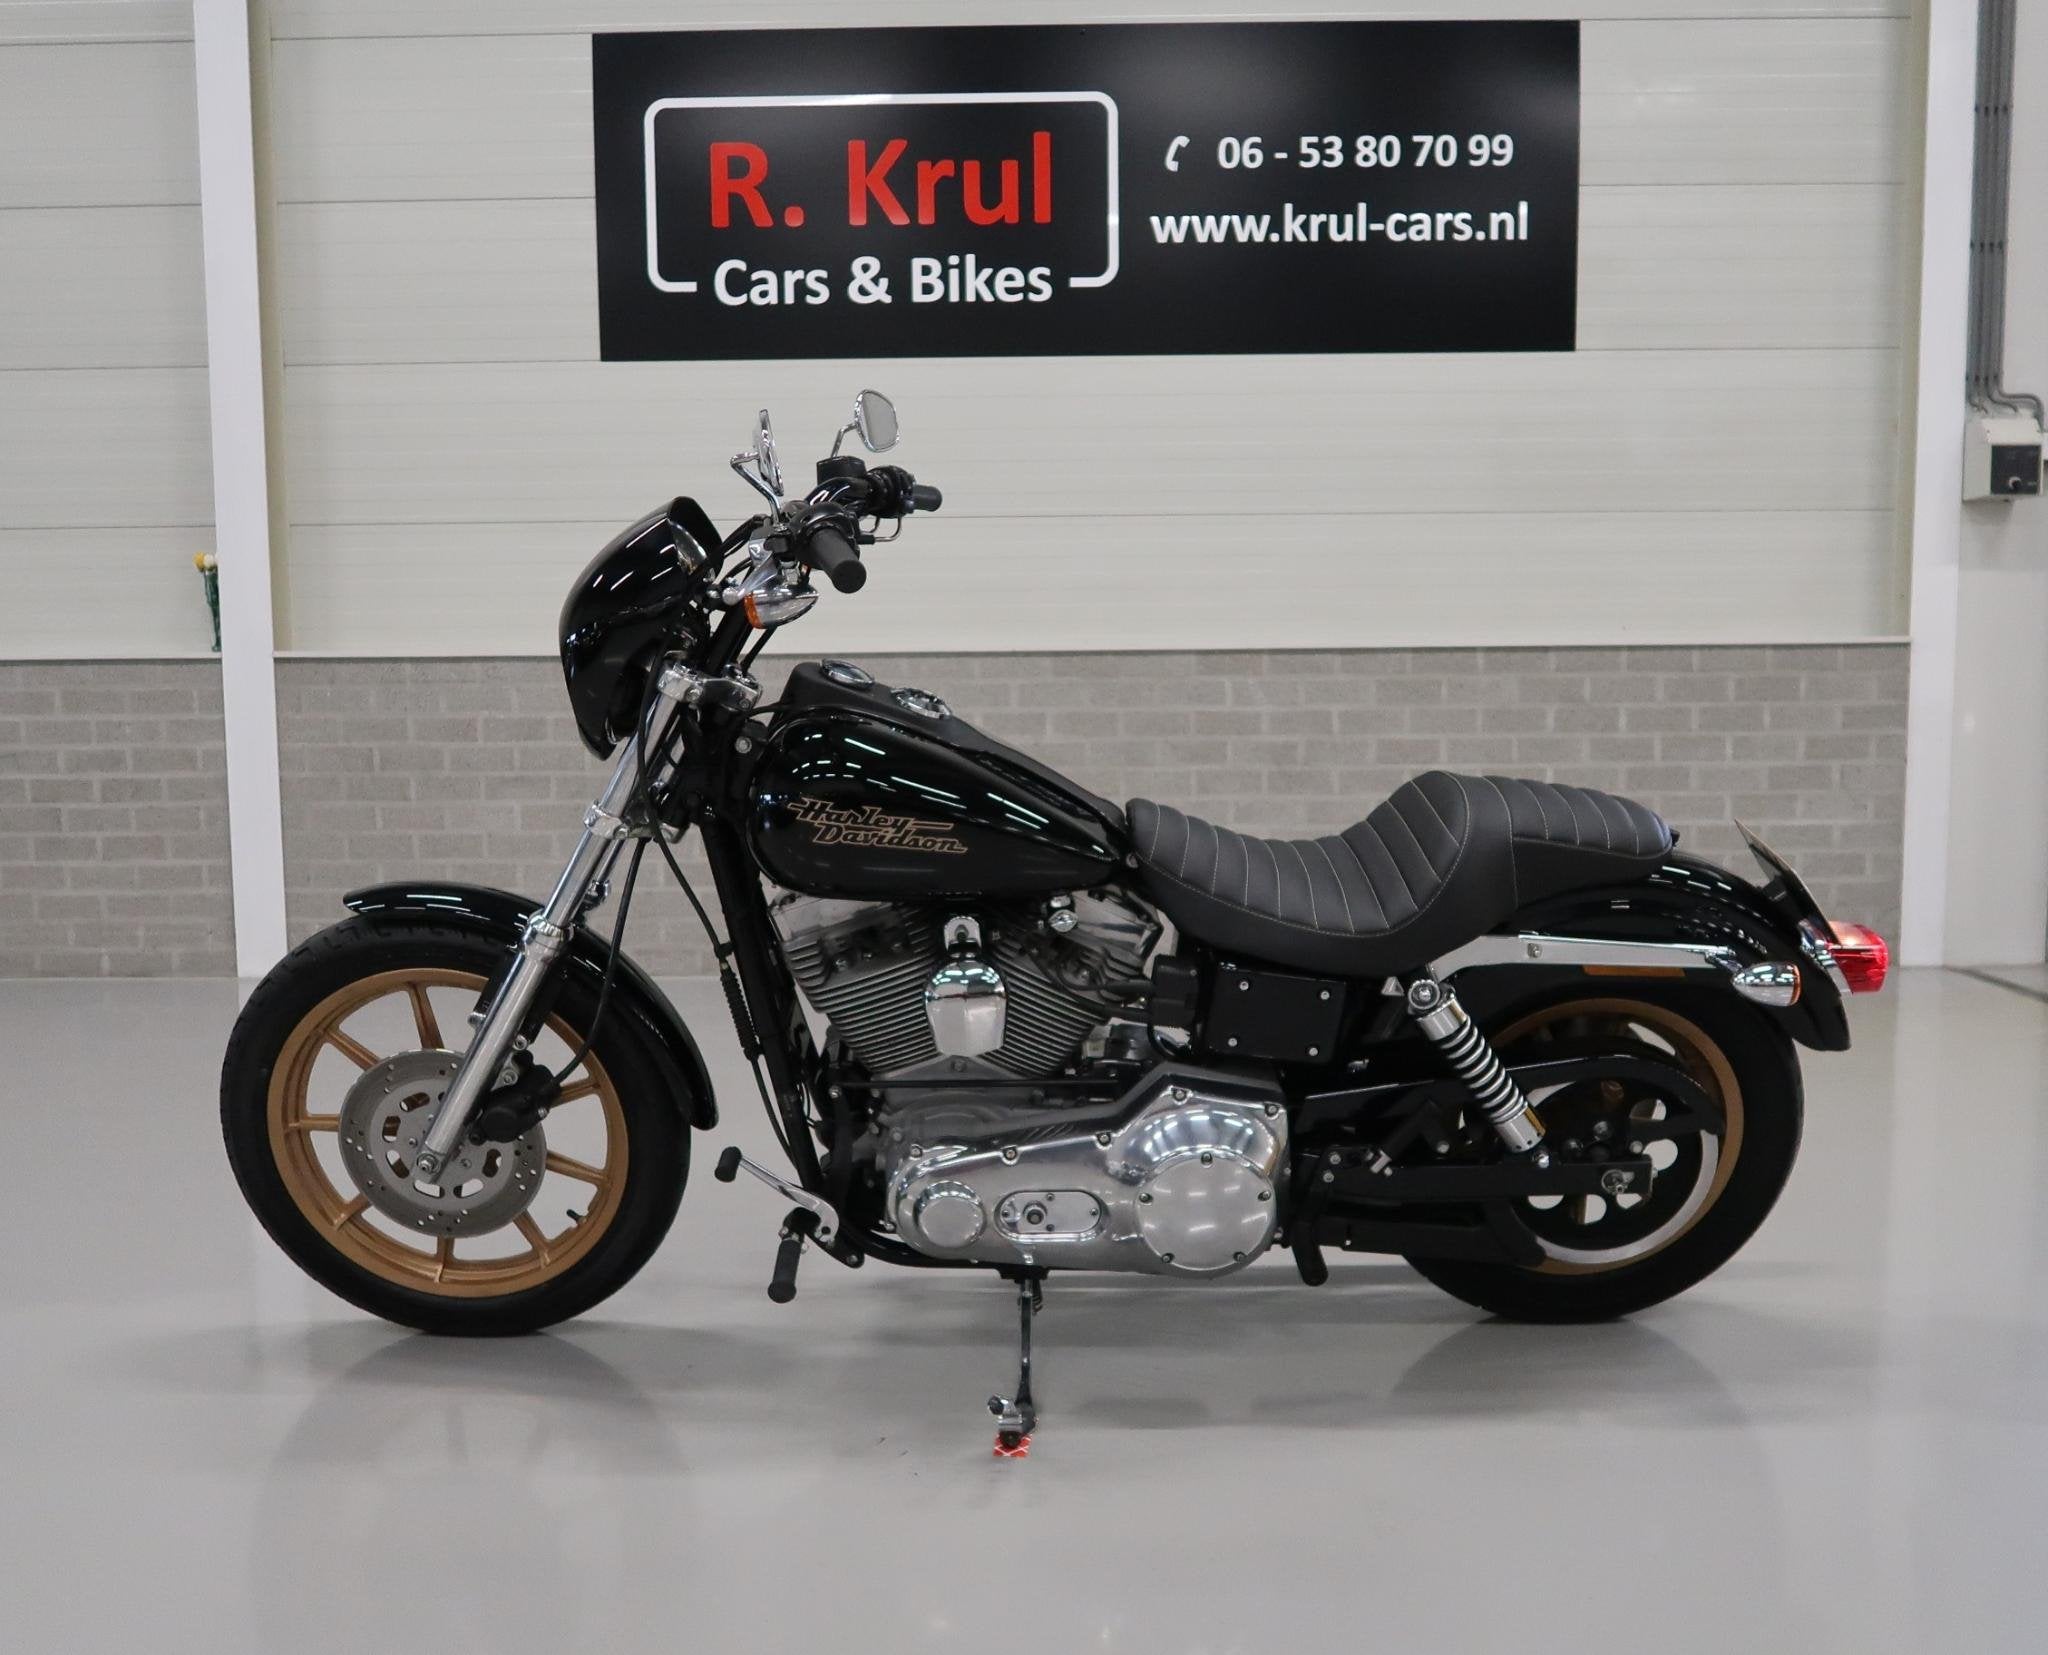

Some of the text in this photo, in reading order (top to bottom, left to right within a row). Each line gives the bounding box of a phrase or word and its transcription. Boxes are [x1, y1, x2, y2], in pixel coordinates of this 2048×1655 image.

[1217, 136, 1264, 170] 06
[1298, 135, 1344, 169] 53
[1354, 134, 1401, 168] 80
[1411, 134, 1458, 168] 70
[1467, 133, 1514, 167] 99
[709, 131, 1052, 228] R. Krul
[1149, 200, 1529, 244] www.krul-cars.nl
[713, 253, 1053, 306] Cars & Bikes
[787, 796, 954, 832] Harley
[813, 821, 968, 854] Davidson
